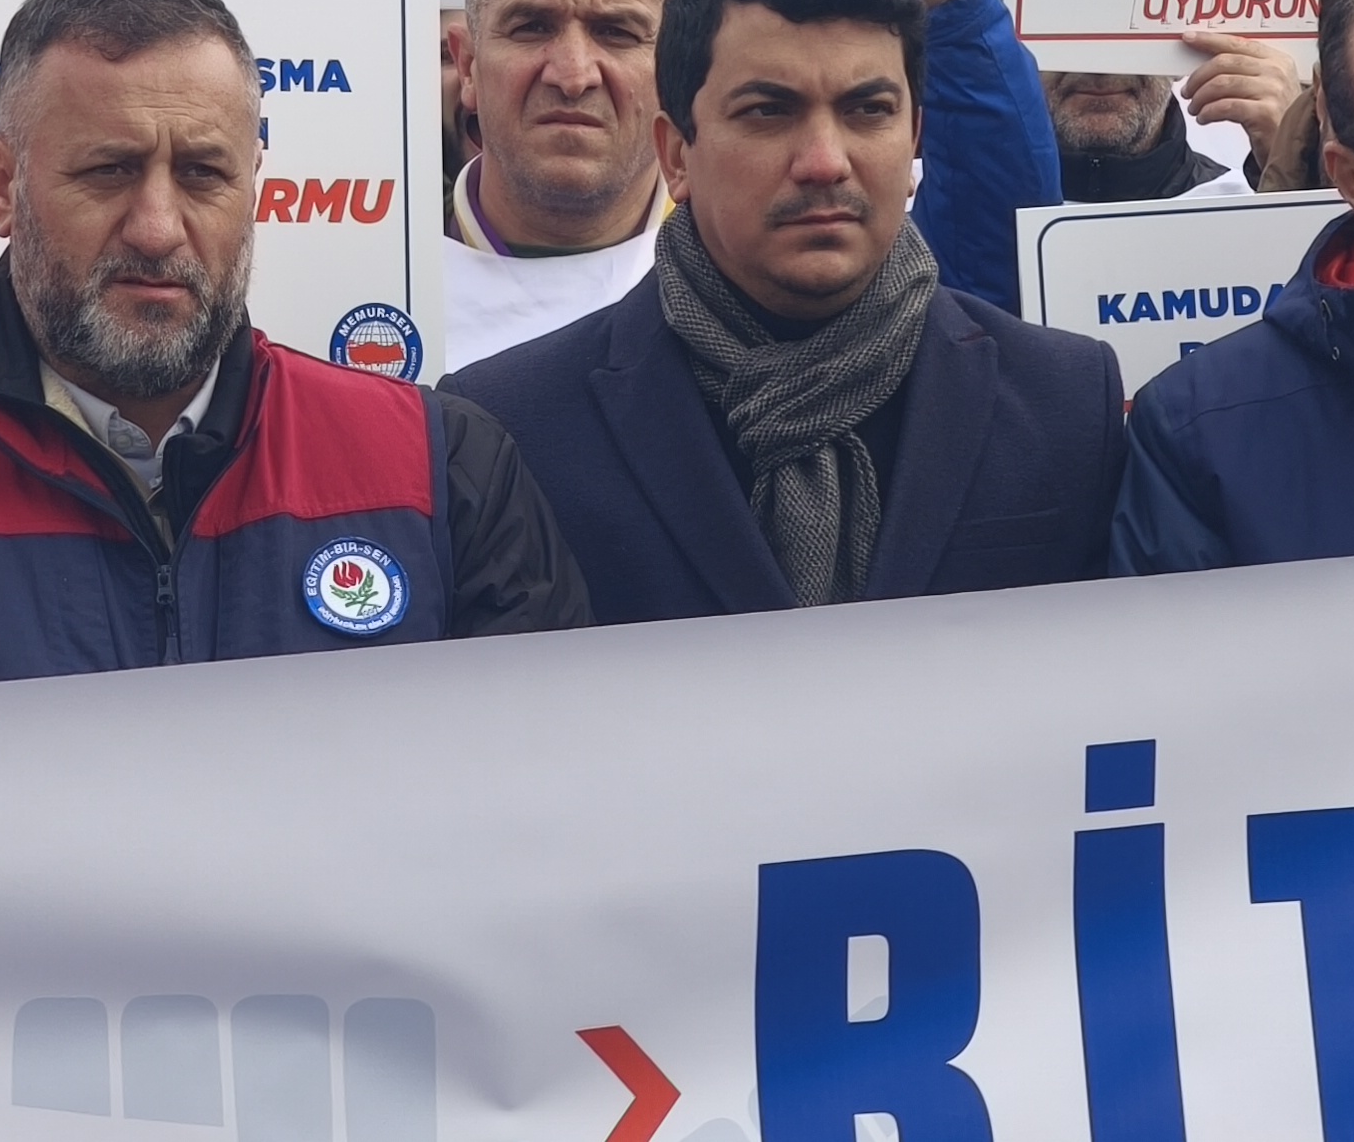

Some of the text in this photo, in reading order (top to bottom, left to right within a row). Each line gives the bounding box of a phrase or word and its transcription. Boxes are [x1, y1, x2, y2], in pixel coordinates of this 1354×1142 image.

[255, 58, 352, 98] ŞMA
[255, 178, 395, 224] RMU
[338, 307, 413, 337] MEMUR-SEN
